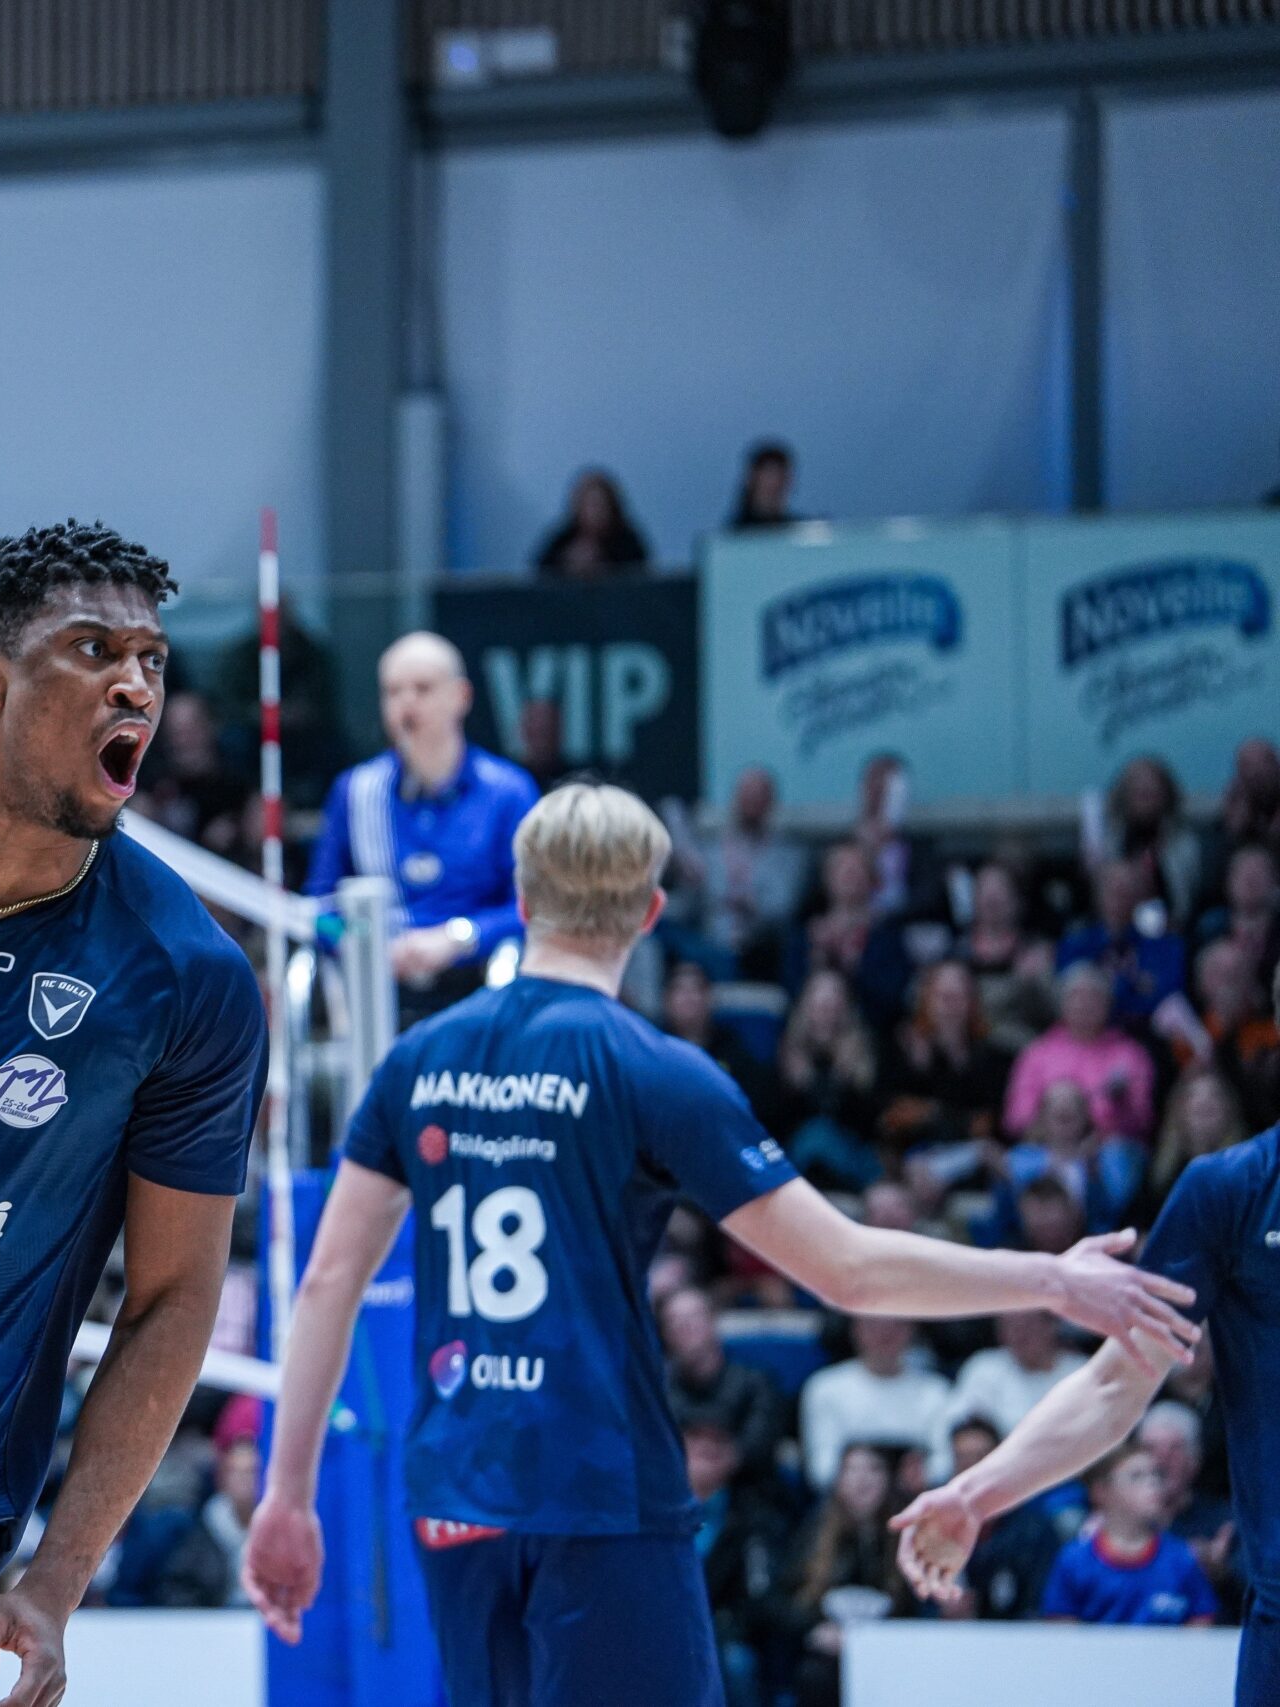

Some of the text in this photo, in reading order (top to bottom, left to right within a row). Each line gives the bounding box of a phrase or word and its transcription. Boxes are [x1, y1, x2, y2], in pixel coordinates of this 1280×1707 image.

[483, 642, 672, 763] VIP
[41, 979, 88, 998] AC OULU
[2, 1097, 28, 1112] 25-26
[410, 1069, 589, 1119] MAKKONEN
[431, 1184, 549, 1322] 18
